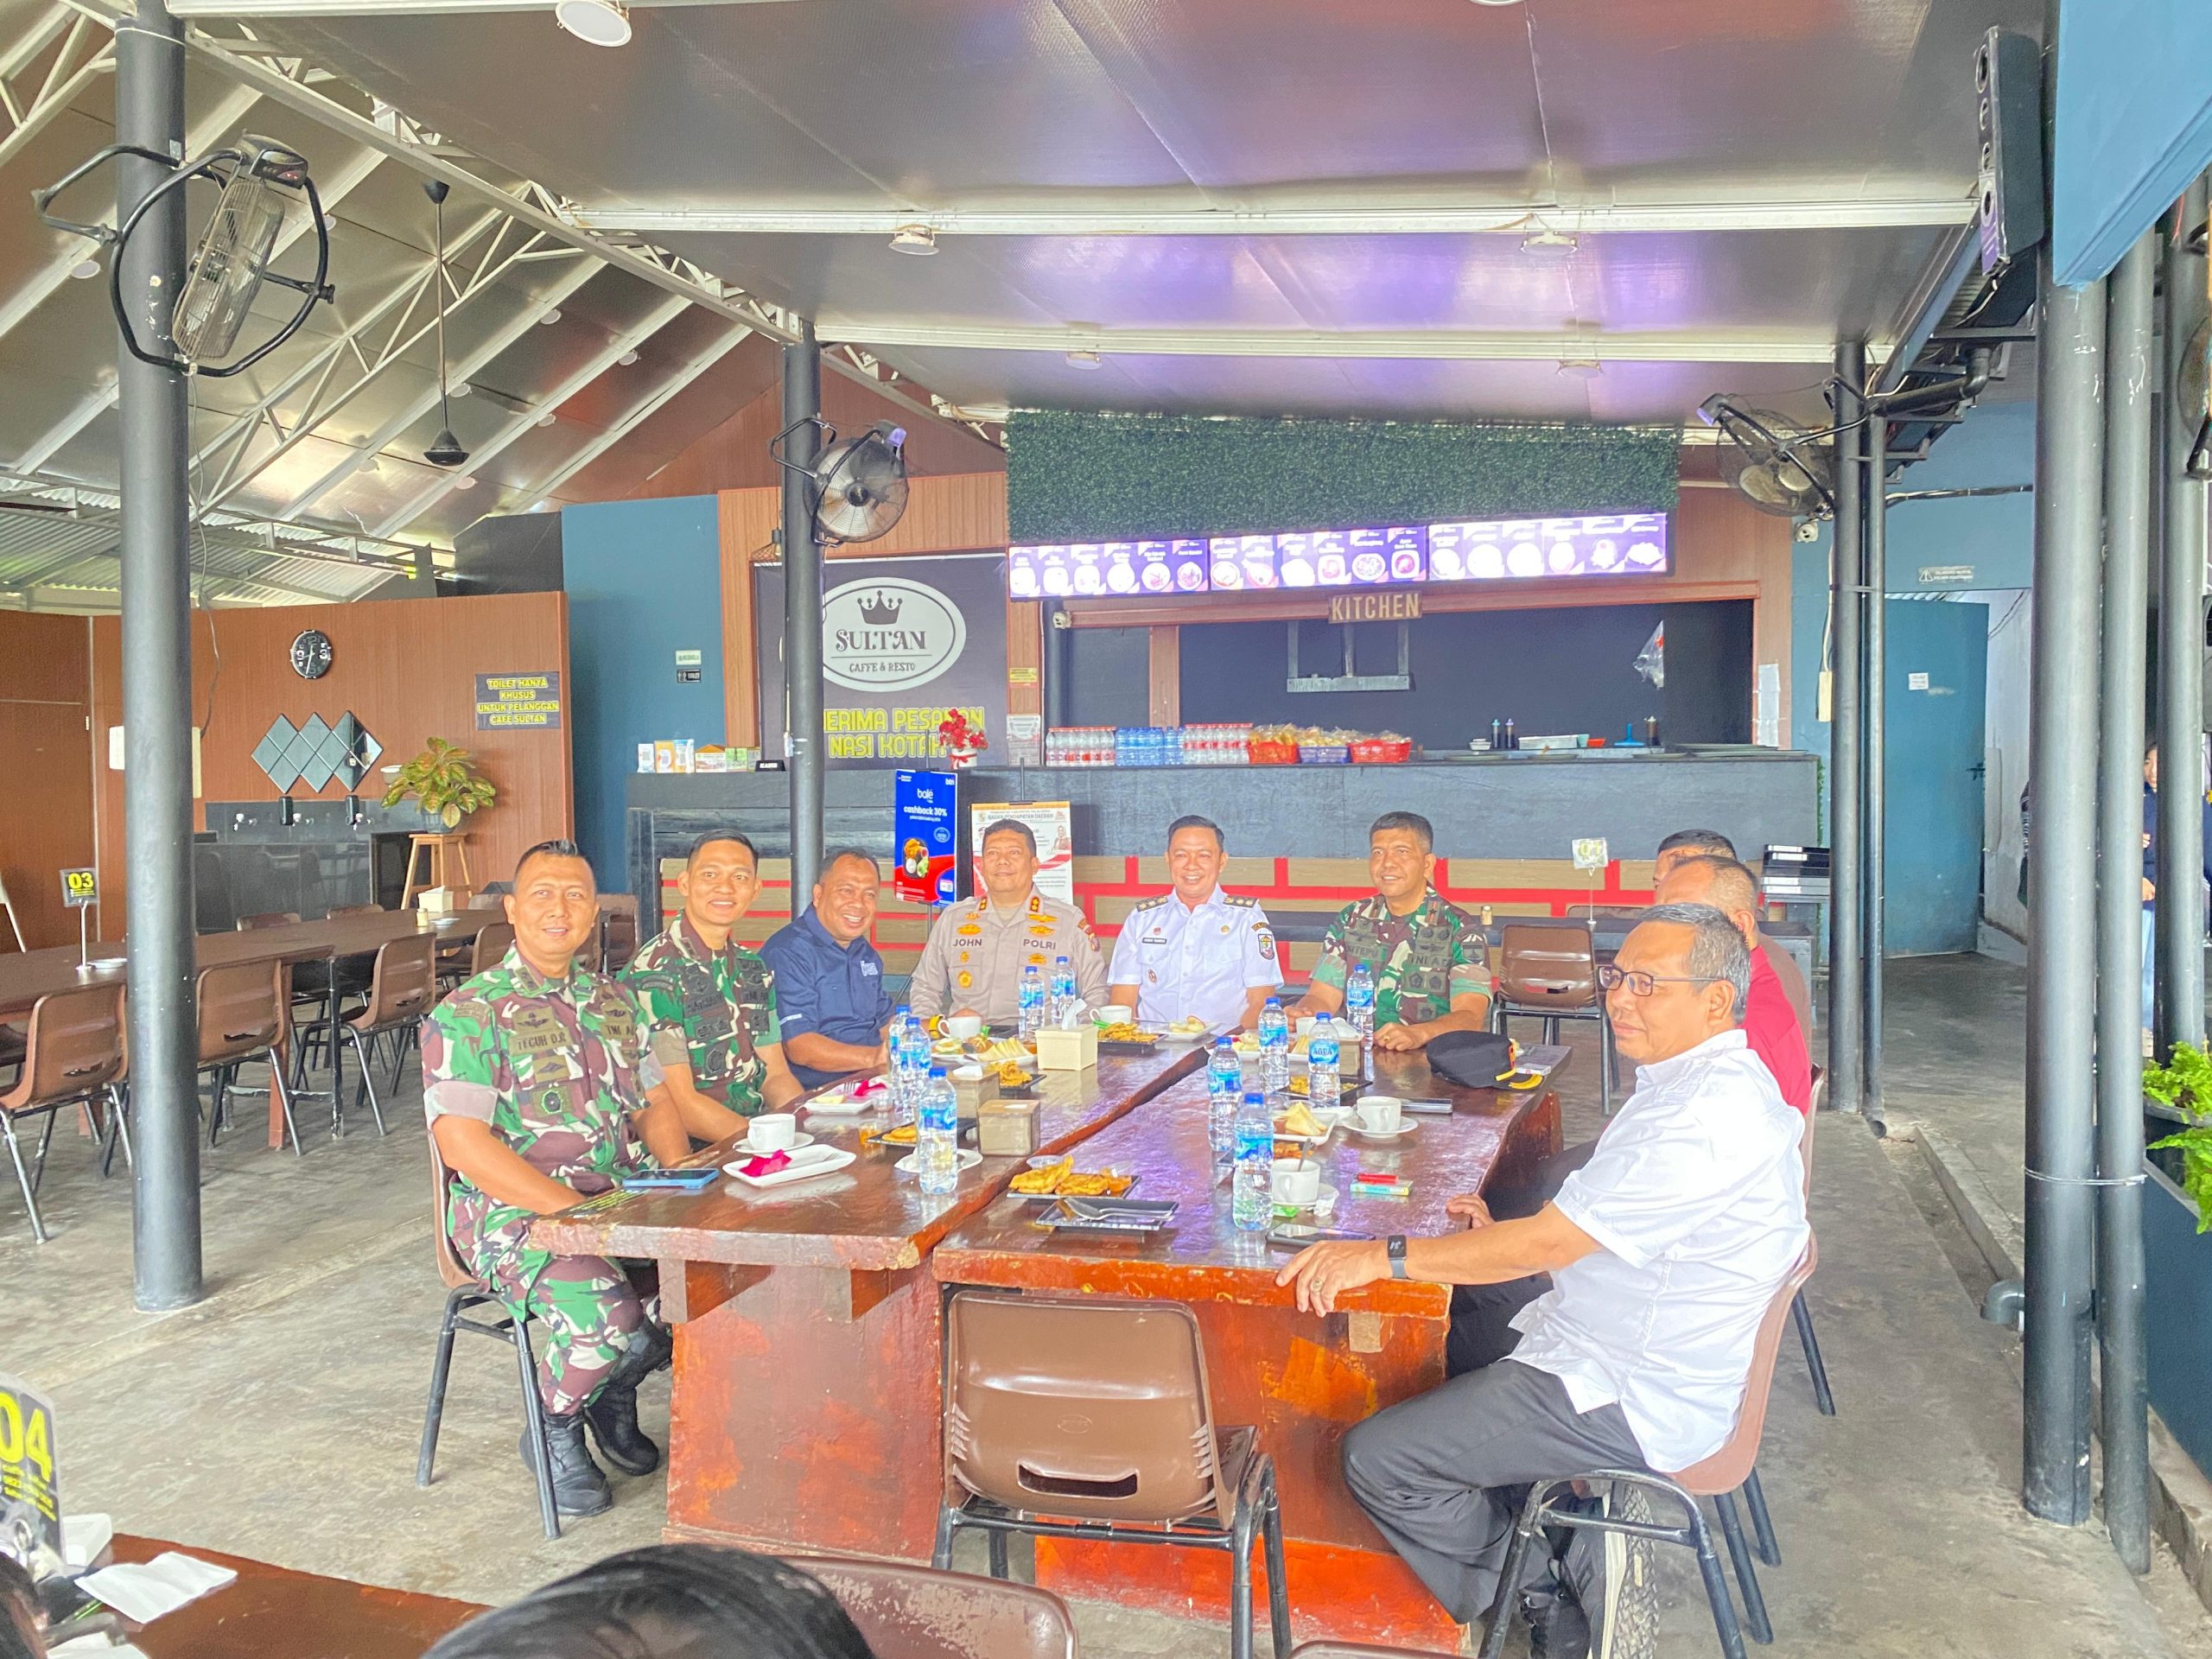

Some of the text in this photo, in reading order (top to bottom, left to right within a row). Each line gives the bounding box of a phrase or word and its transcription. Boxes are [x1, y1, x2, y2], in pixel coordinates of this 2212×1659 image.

[1332, 593, 1419, 620] KITCHEN
[836, 629, 926, 652] SULTAN
[849, 662, 916, 672] CAFFE & RESTO
[486, 677, 548, 690] TOILET HANYA
[499, 690, 536, 701] KHUSUS
[477, 701, 560, 714] UNTUK PELANGGAN
[489, 713, 547, 725] CAFE SULTAN
[829, 734, 874, 759] NASI
[903, 805, 948, 817] cashback 30%
[68, 872, 94, 889] 03
[953, 938, 982, 947] JOHN
[1023, 938, 1056, 950] POLRI
[1410, 954, 1427, 964] TNI
[1313, 1047, 1333, 1056] AQUA
[0, 1392, 52, 1483] 04
